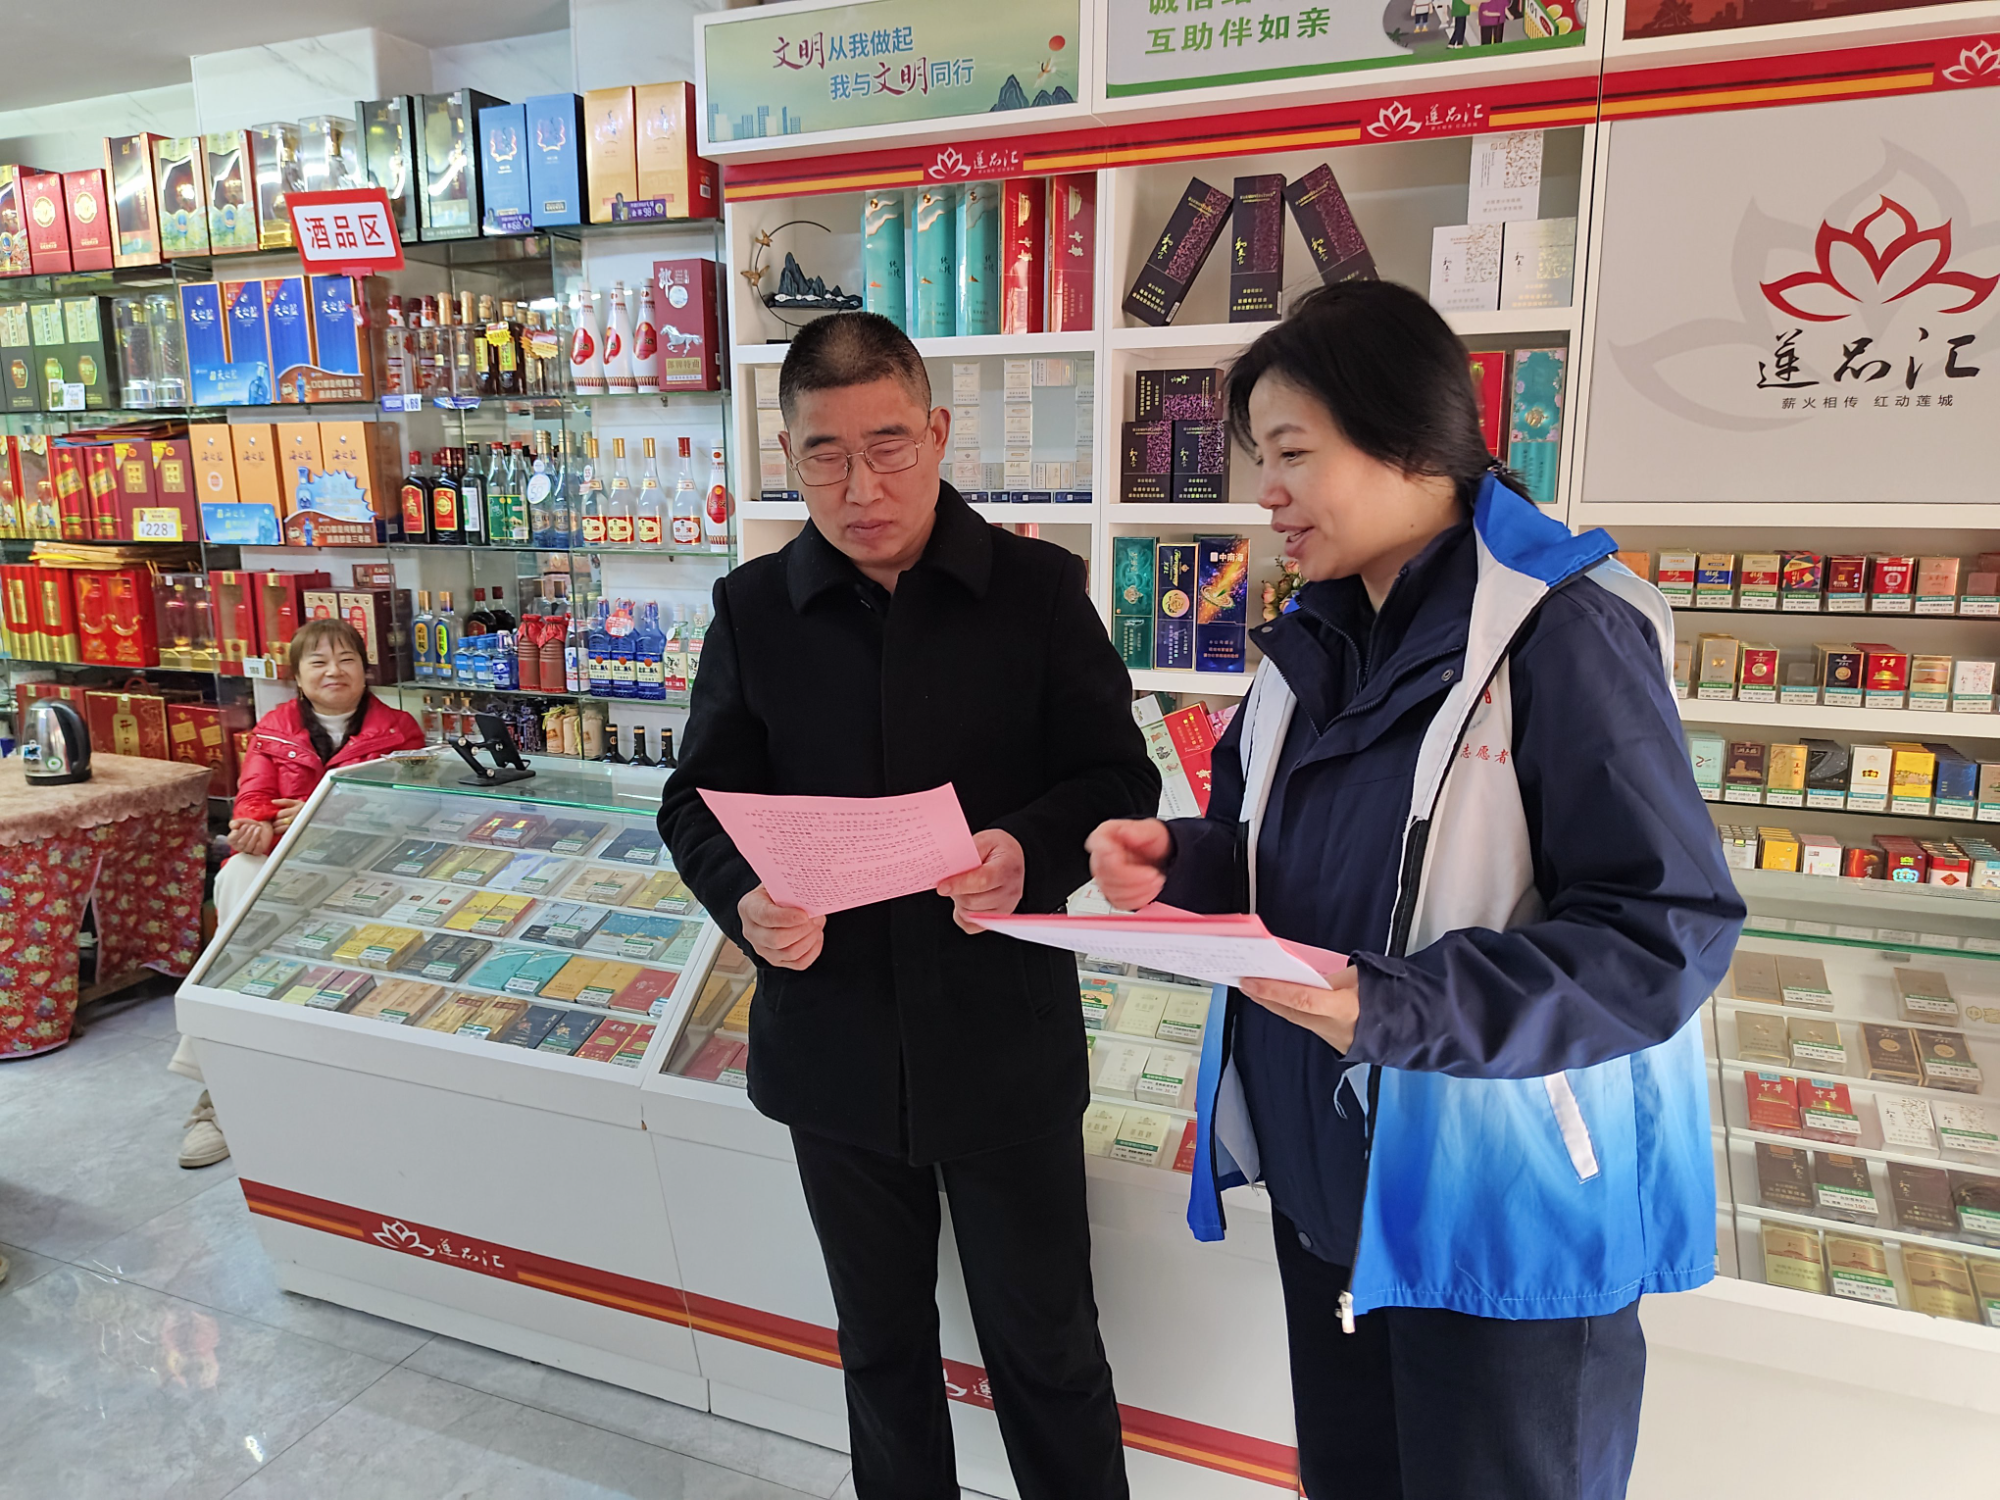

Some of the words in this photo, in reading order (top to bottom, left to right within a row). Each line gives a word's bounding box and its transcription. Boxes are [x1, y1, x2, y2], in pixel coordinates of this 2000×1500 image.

[772, 26, 914, 70] 文明从我做起
[1145, 7, 1331, 55] 互助伴如亲
[829, 56, 974, 101] 我与文明同行
[304, 213, 386, 250] 酒品区
[1781, 396, 1859, 410] 薪火相传
[1873, 394, 1954, 408] 红动莲城
[1218, 552, 1244, 563] 中南海
[1460, 743, 1509, 765] 志愿者
